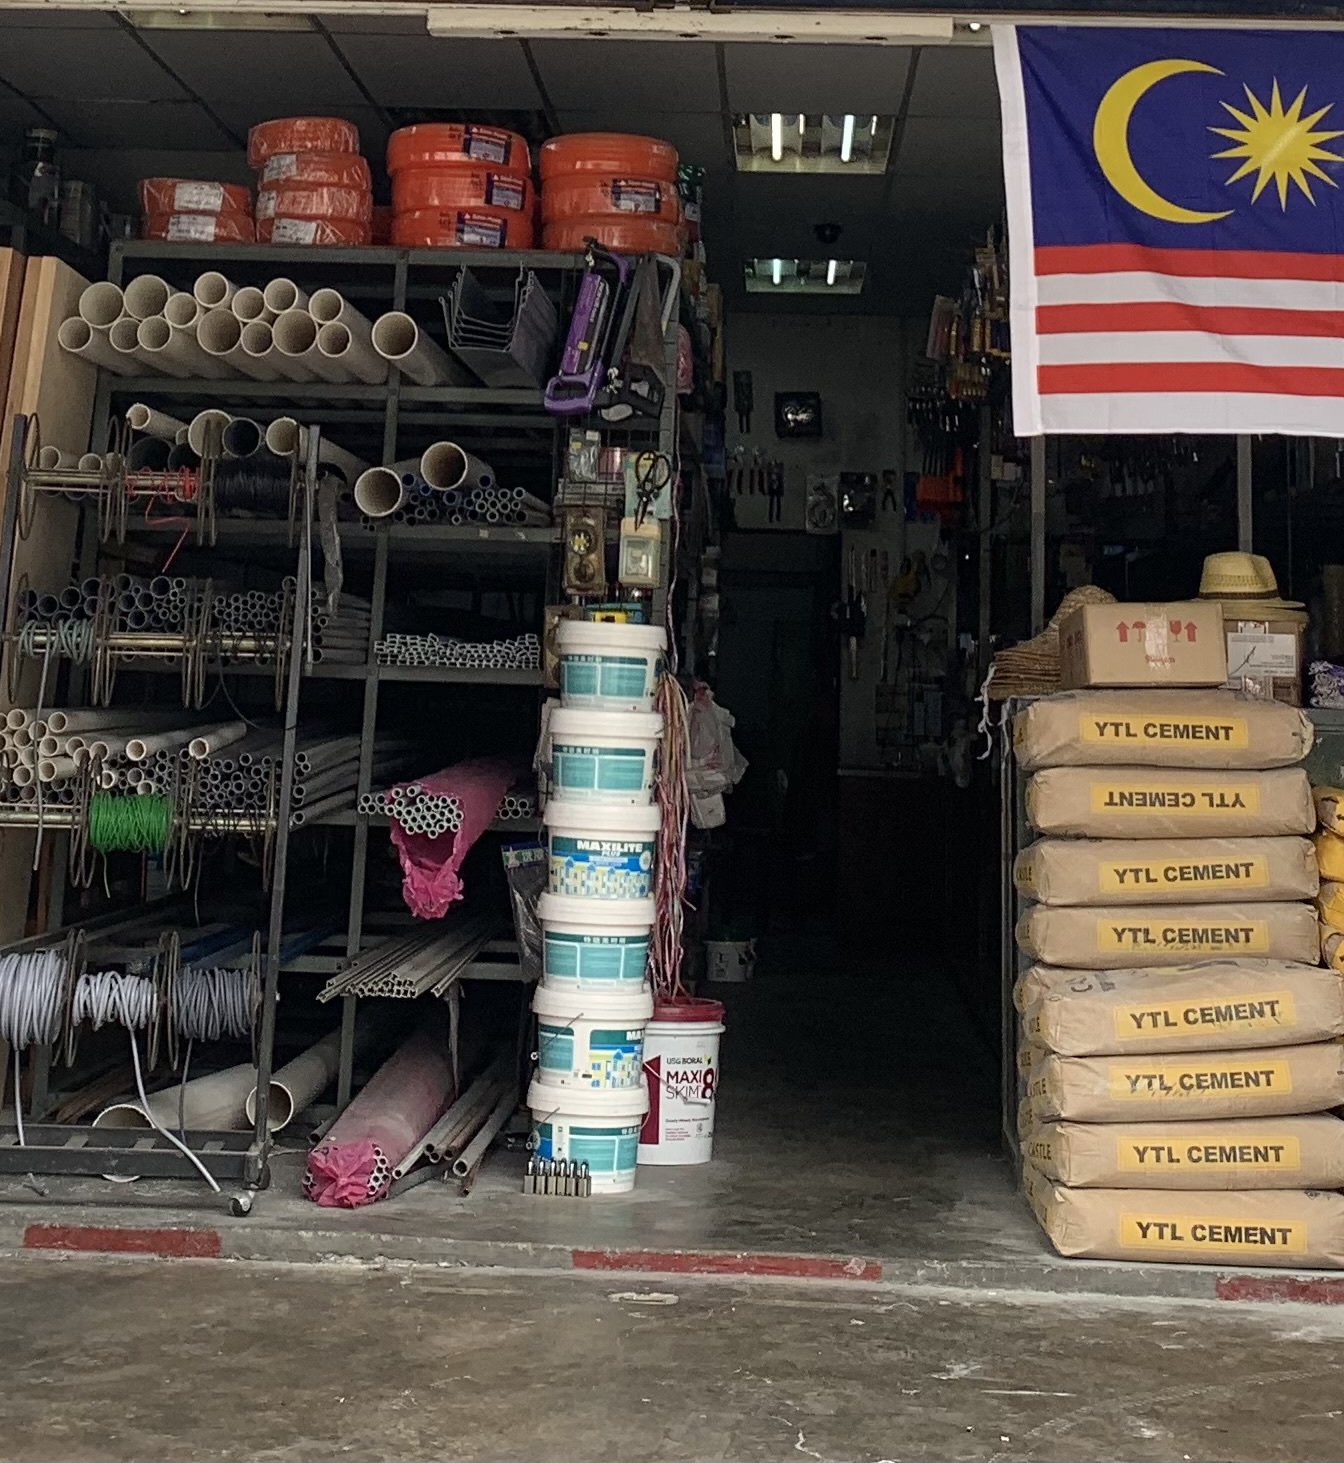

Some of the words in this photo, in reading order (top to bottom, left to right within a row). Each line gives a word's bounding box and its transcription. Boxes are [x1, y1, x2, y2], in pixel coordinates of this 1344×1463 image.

[1094, 721, 1137, 738] YTL
[1143, 722, 1234, 741] CEMENT
[1104, 791, 1196, 808] CEMENT
[1201, 792, 1246, 809] YTL
[576, 839, 643, 853] MAXILITE
[1113, 867, 1158, 884] YTL
[1163, 862, 1254, 883] CEMENT
[1112, 927, 1156, 944] YTL
[1162, 927, 1254, 944] CEMENT
[1129, 1010, 1178, 1029] YTL
[1183, 999, 1280, 1024] CEMENT
[682, 1056, 703, 1064] BORAL
[666, 1069, 702, 1084] MAXI
[702, 1067, 715, 1102] 8
[1125, 1073, 1173, 1093] YTL
[1178, 1070, 1275, 1090] CEMENT
[1133, 1145, 1180, 1163] YTL
[1186, 1145, 1285, 1163] CEMENT
[1135, 1221, 1184, 1241] YTL
[1190, 1224, 1293, 1245] CEMENT
